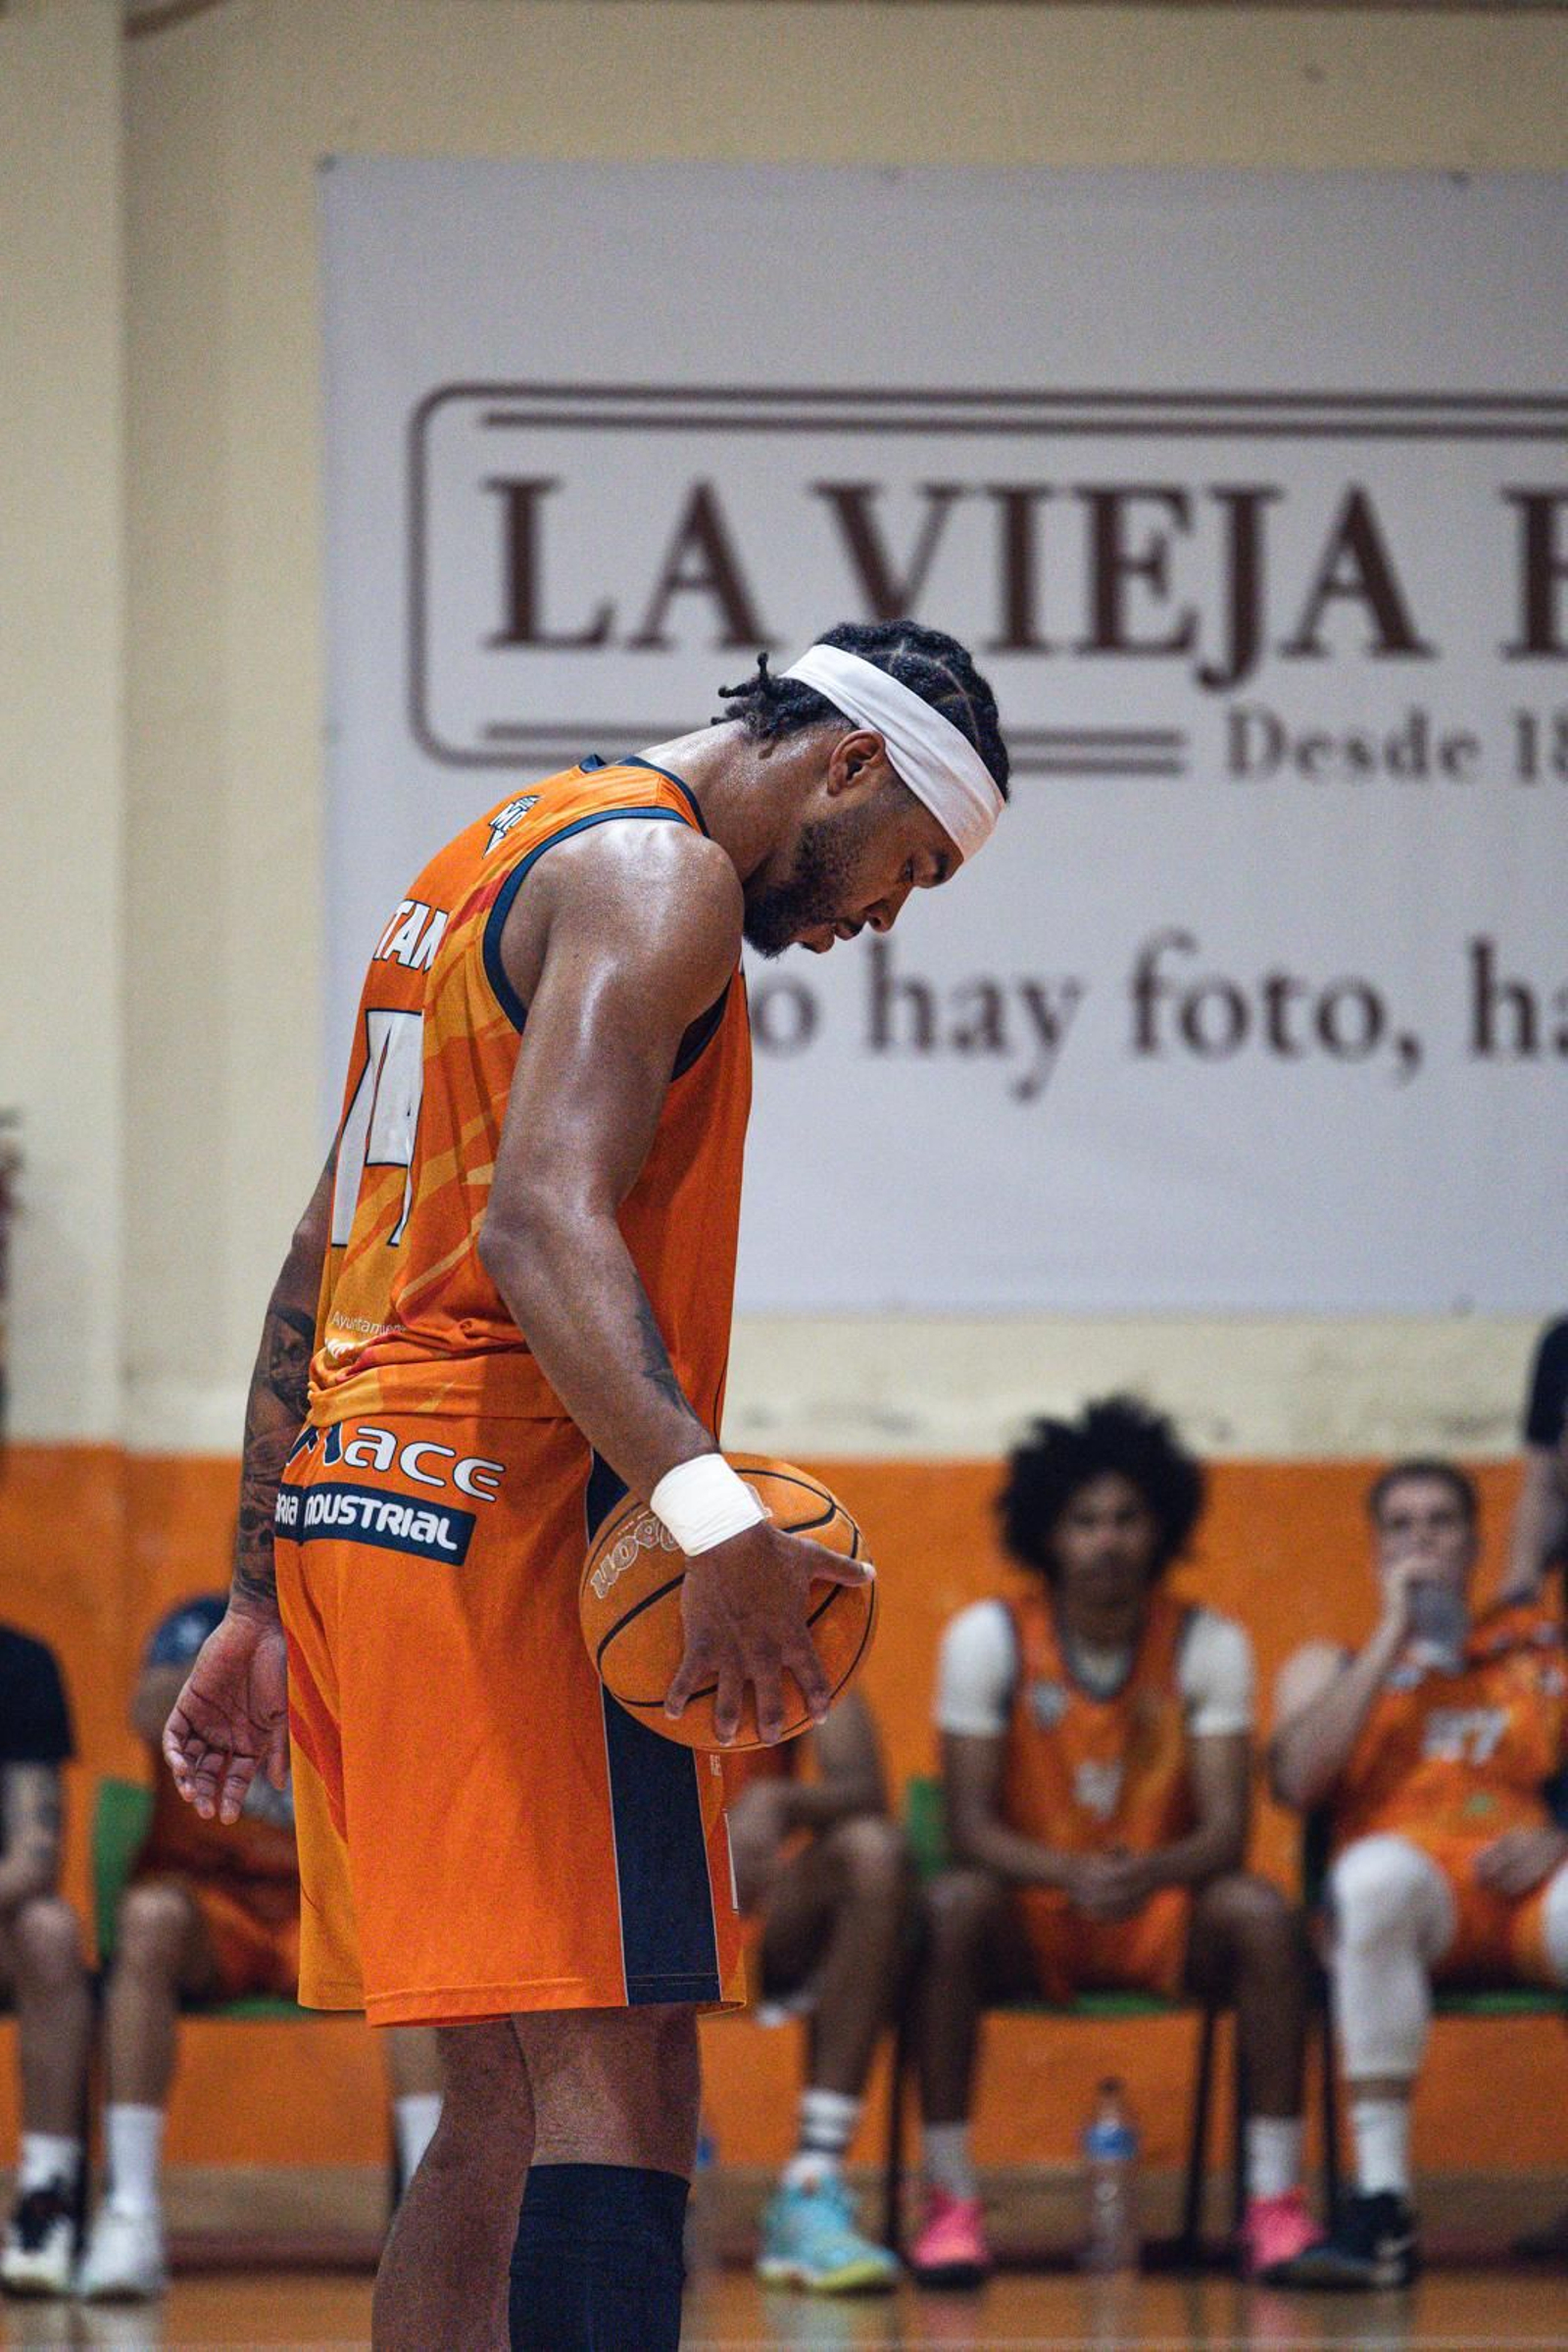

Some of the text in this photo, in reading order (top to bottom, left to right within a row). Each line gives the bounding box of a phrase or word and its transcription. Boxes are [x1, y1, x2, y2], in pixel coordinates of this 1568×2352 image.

[482, 476, 781, 650] LA
[810, 479, 1438, 693] VIEJA
[1225, 705, 1481, 781] Desde
[864, 933, 1085, 1104] hay
[1129, 928, 1424, 1082] foto,
